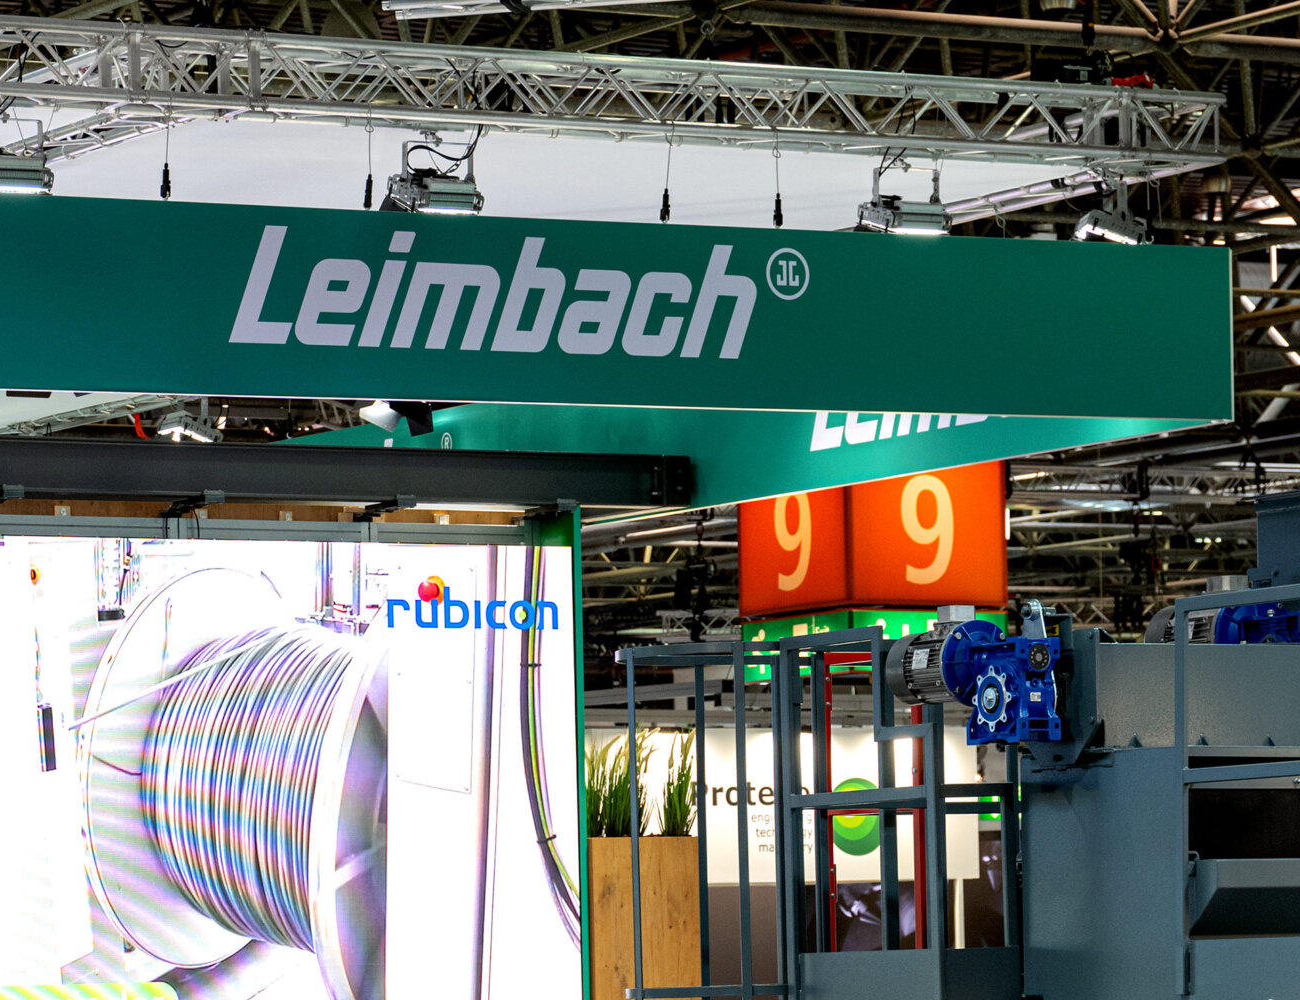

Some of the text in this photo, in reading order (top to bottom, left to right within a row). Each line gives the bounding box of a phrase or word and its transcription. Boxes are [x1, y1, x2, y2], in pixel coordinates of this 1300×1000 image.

[229, 225, 757, 359] Leimbach
[773, 492, 812, 591] 9
[901, 474, 954, 585] 9
[386, 586, 559, 630] rubicon
